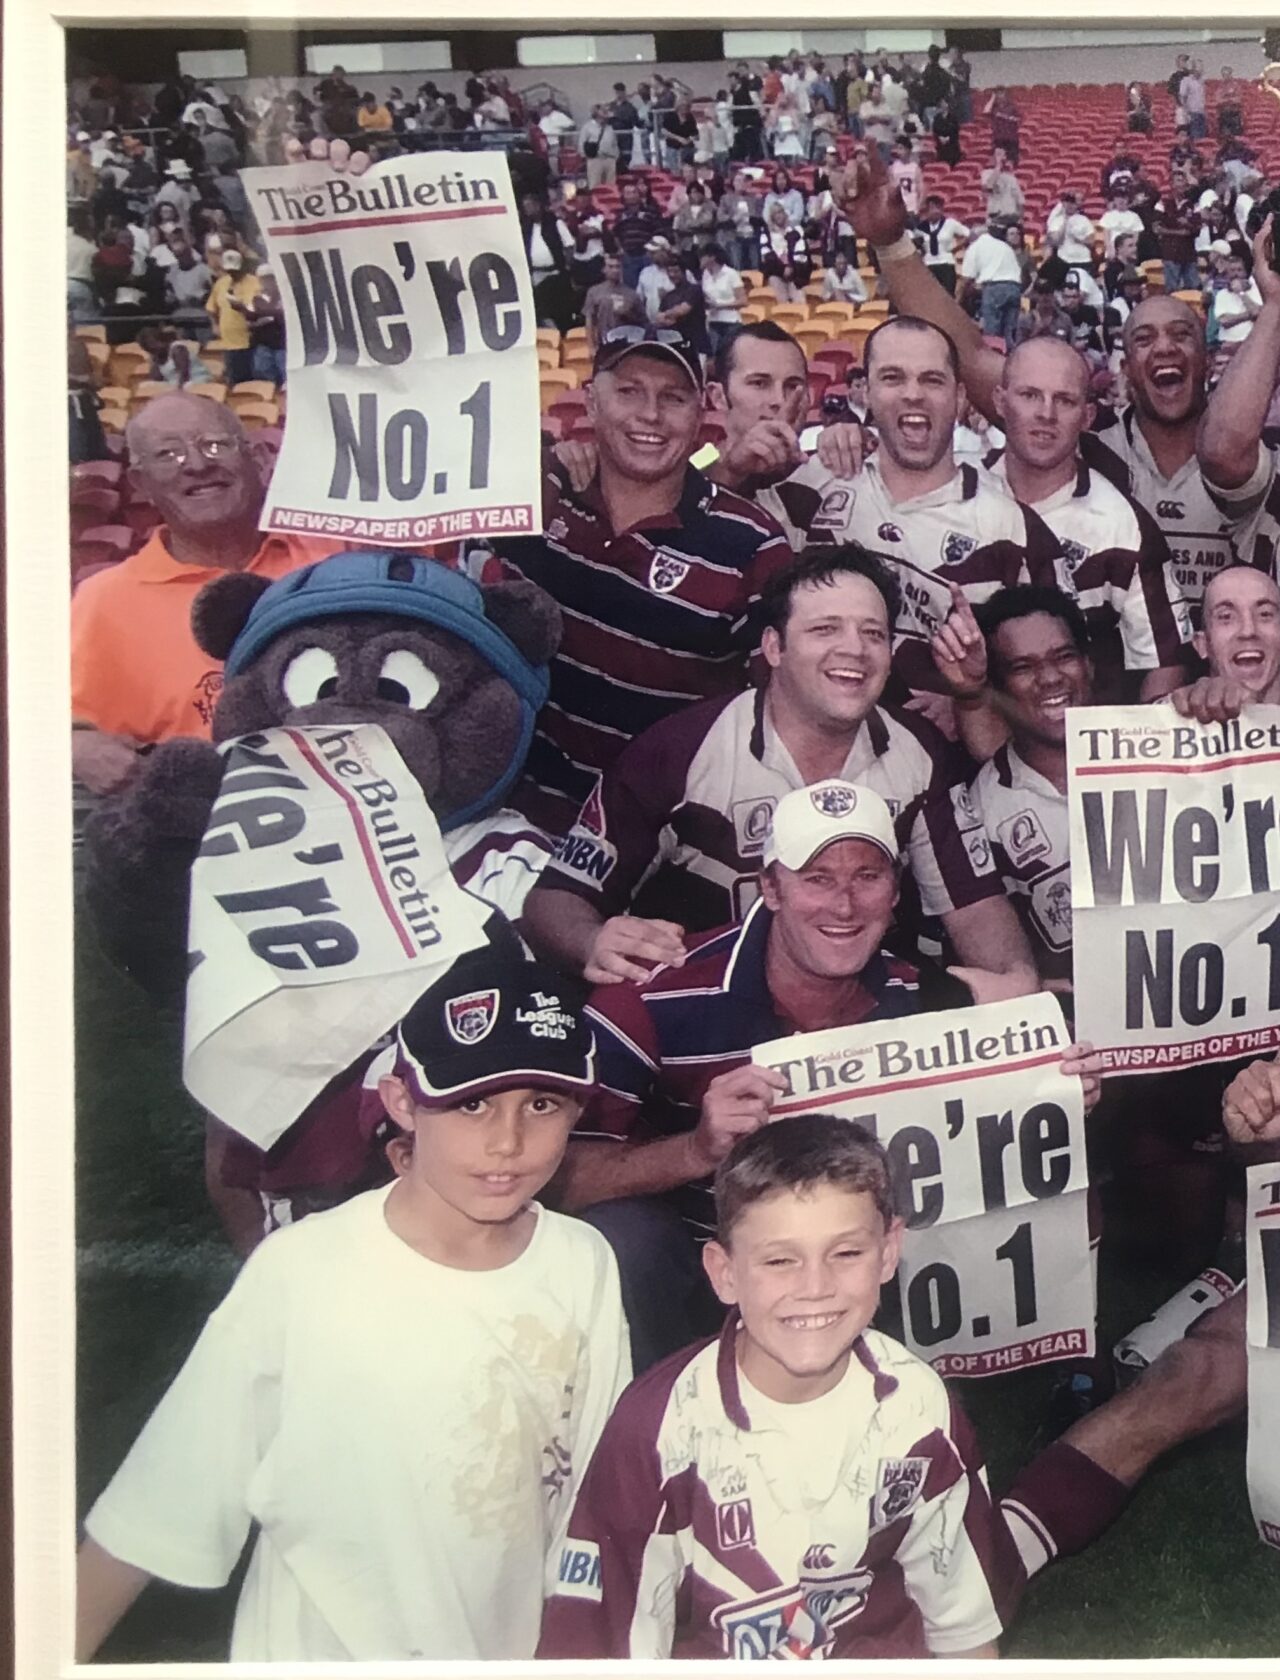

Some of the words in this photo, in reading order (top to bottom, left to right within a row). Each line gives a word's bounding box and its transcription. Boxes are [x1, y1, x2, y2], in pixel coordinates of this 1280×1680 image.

[258, 186, 325, 221] The
[326, 172, 498, 214] Bulletin
[280, 241, 522, 366] We're
[328, 381, 491, 502] No.1
[275, 510, 409, 538] NEWSPAPER
[413, 518, 437, 537] OF
[438, 510, 473, 533] THE
[473, 507, 529, 532] YEAR
[1079, 728, 1161, 760] The
[306, 728, 363, 779] he
[353, 777, 442, 950] Bulletin
[530, 1022, 567, 1040] Club
[769, 1055, 865, 1098] The
[876, 1020, 1059, 1078] Bulletin
[1102, 1041, 1206, 1068] EWSPAPER
[1208, 1035, 1234, 1054] OF
[1236, 1029, 1272, 1049] THE
[853, 1098, 1071, 1232] e're
[908, 1222, 1038, 1347] o.1
[951, 1355, 979, 1371] OF
[982, 1346, 1024, 1369] THE
[1025, 1332, 1083, 1357] YEAR
